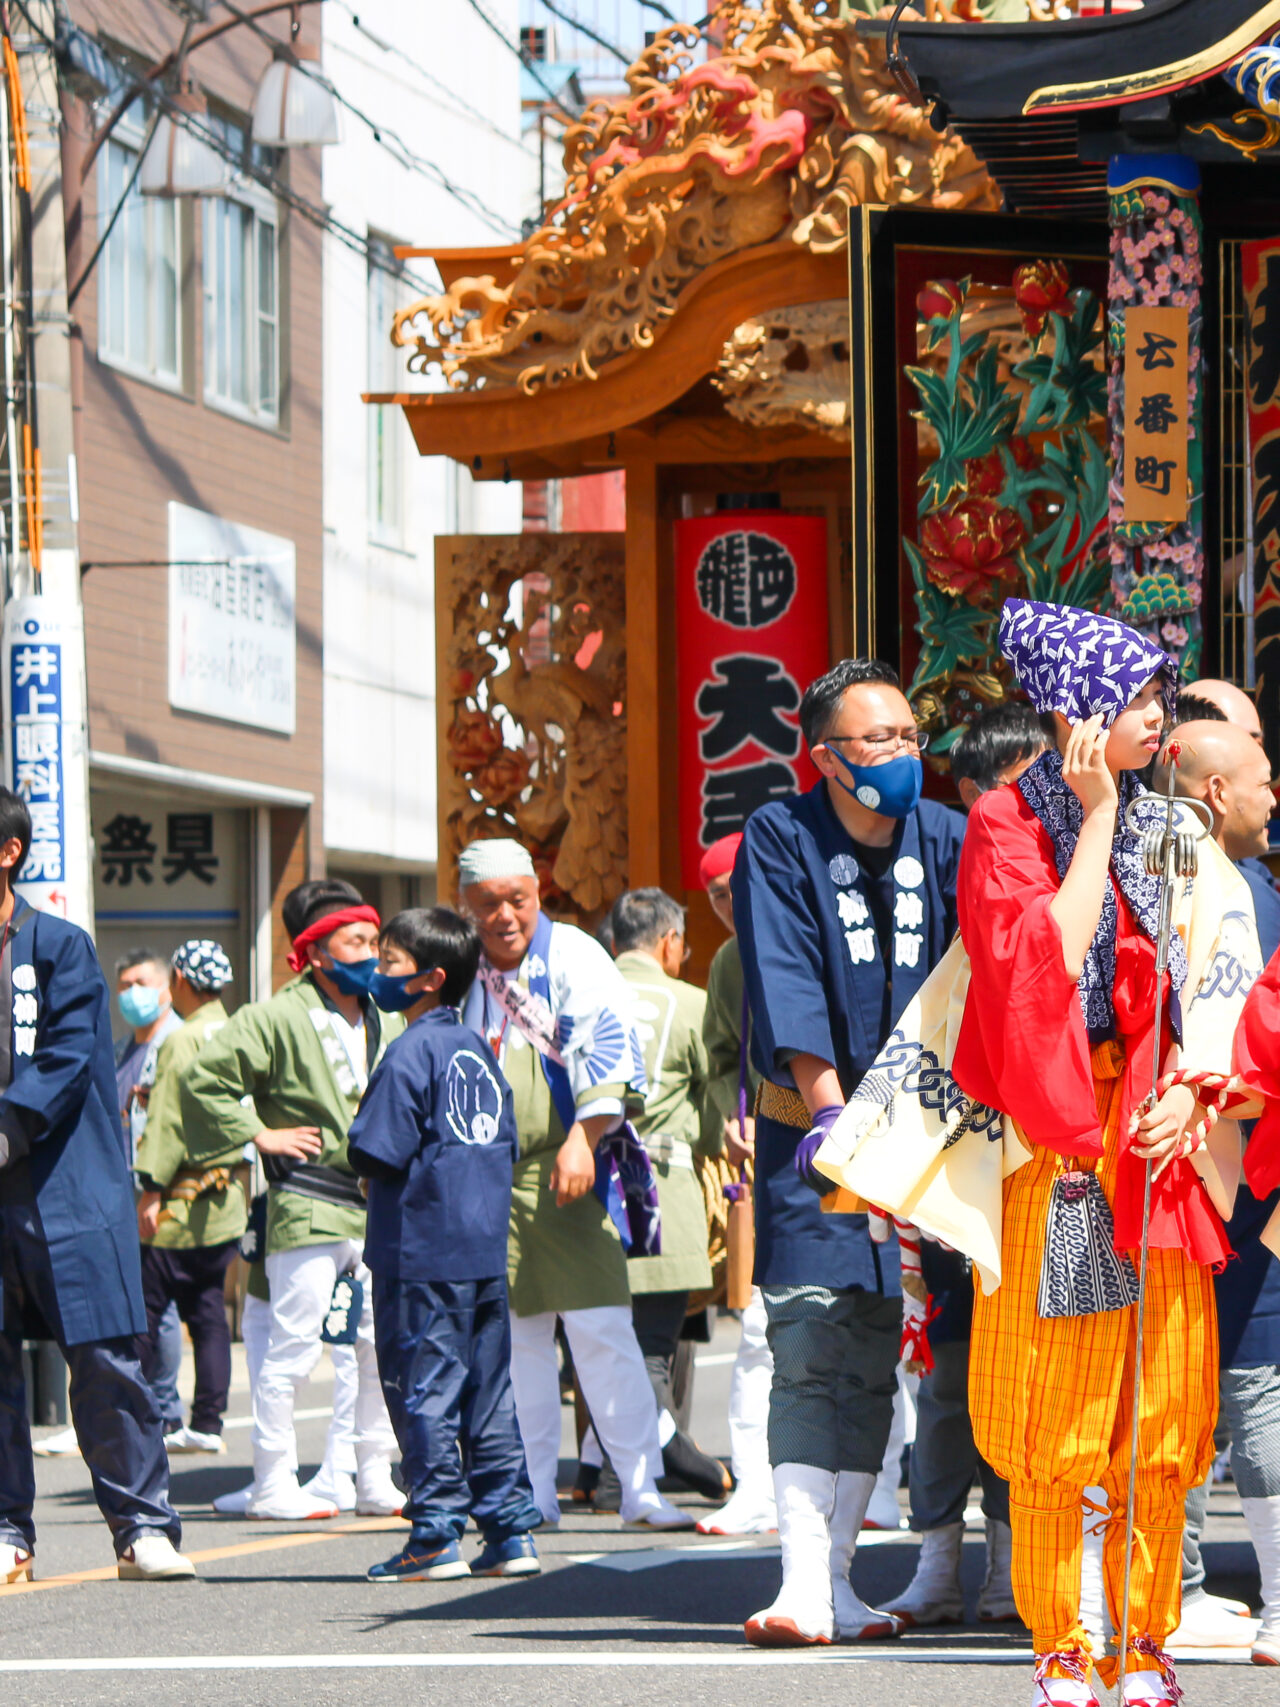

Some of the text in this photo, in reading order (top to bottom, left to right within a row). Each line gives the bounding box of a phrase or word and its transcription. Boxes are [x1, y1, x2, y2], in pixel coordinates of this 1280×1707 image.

[15, 646, 61, 881] 井上眼科医院
[101, 813, 219, 886] 祭具
